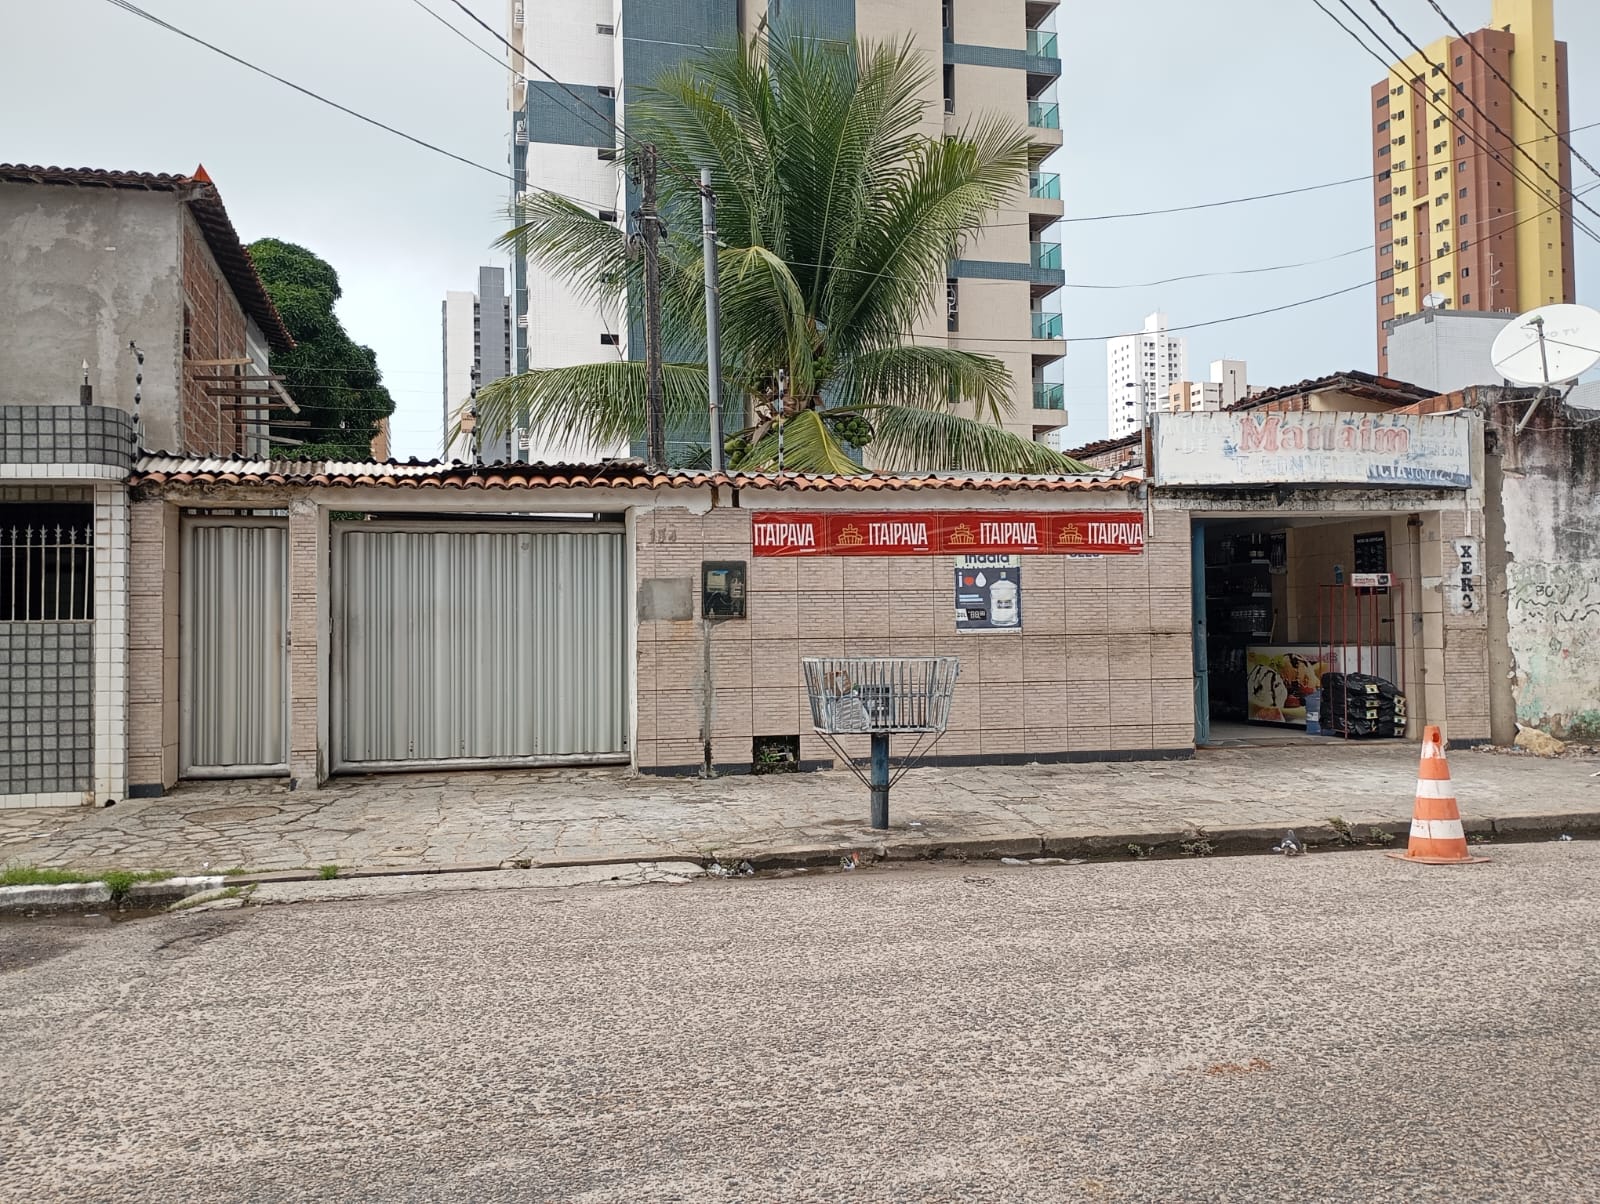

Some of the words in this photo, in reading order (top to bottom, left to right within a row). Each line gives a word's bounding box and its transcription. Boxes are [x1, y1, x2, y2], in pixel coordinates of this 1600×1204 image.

[754, 523, 816, 546] ITAIPAVA
[869, 523, 929, 545] ITAIPAVA
[980, 522, 1038, 545] ITAIPAVA
[1088, 522, 1144, 545] ITAIPAVA
